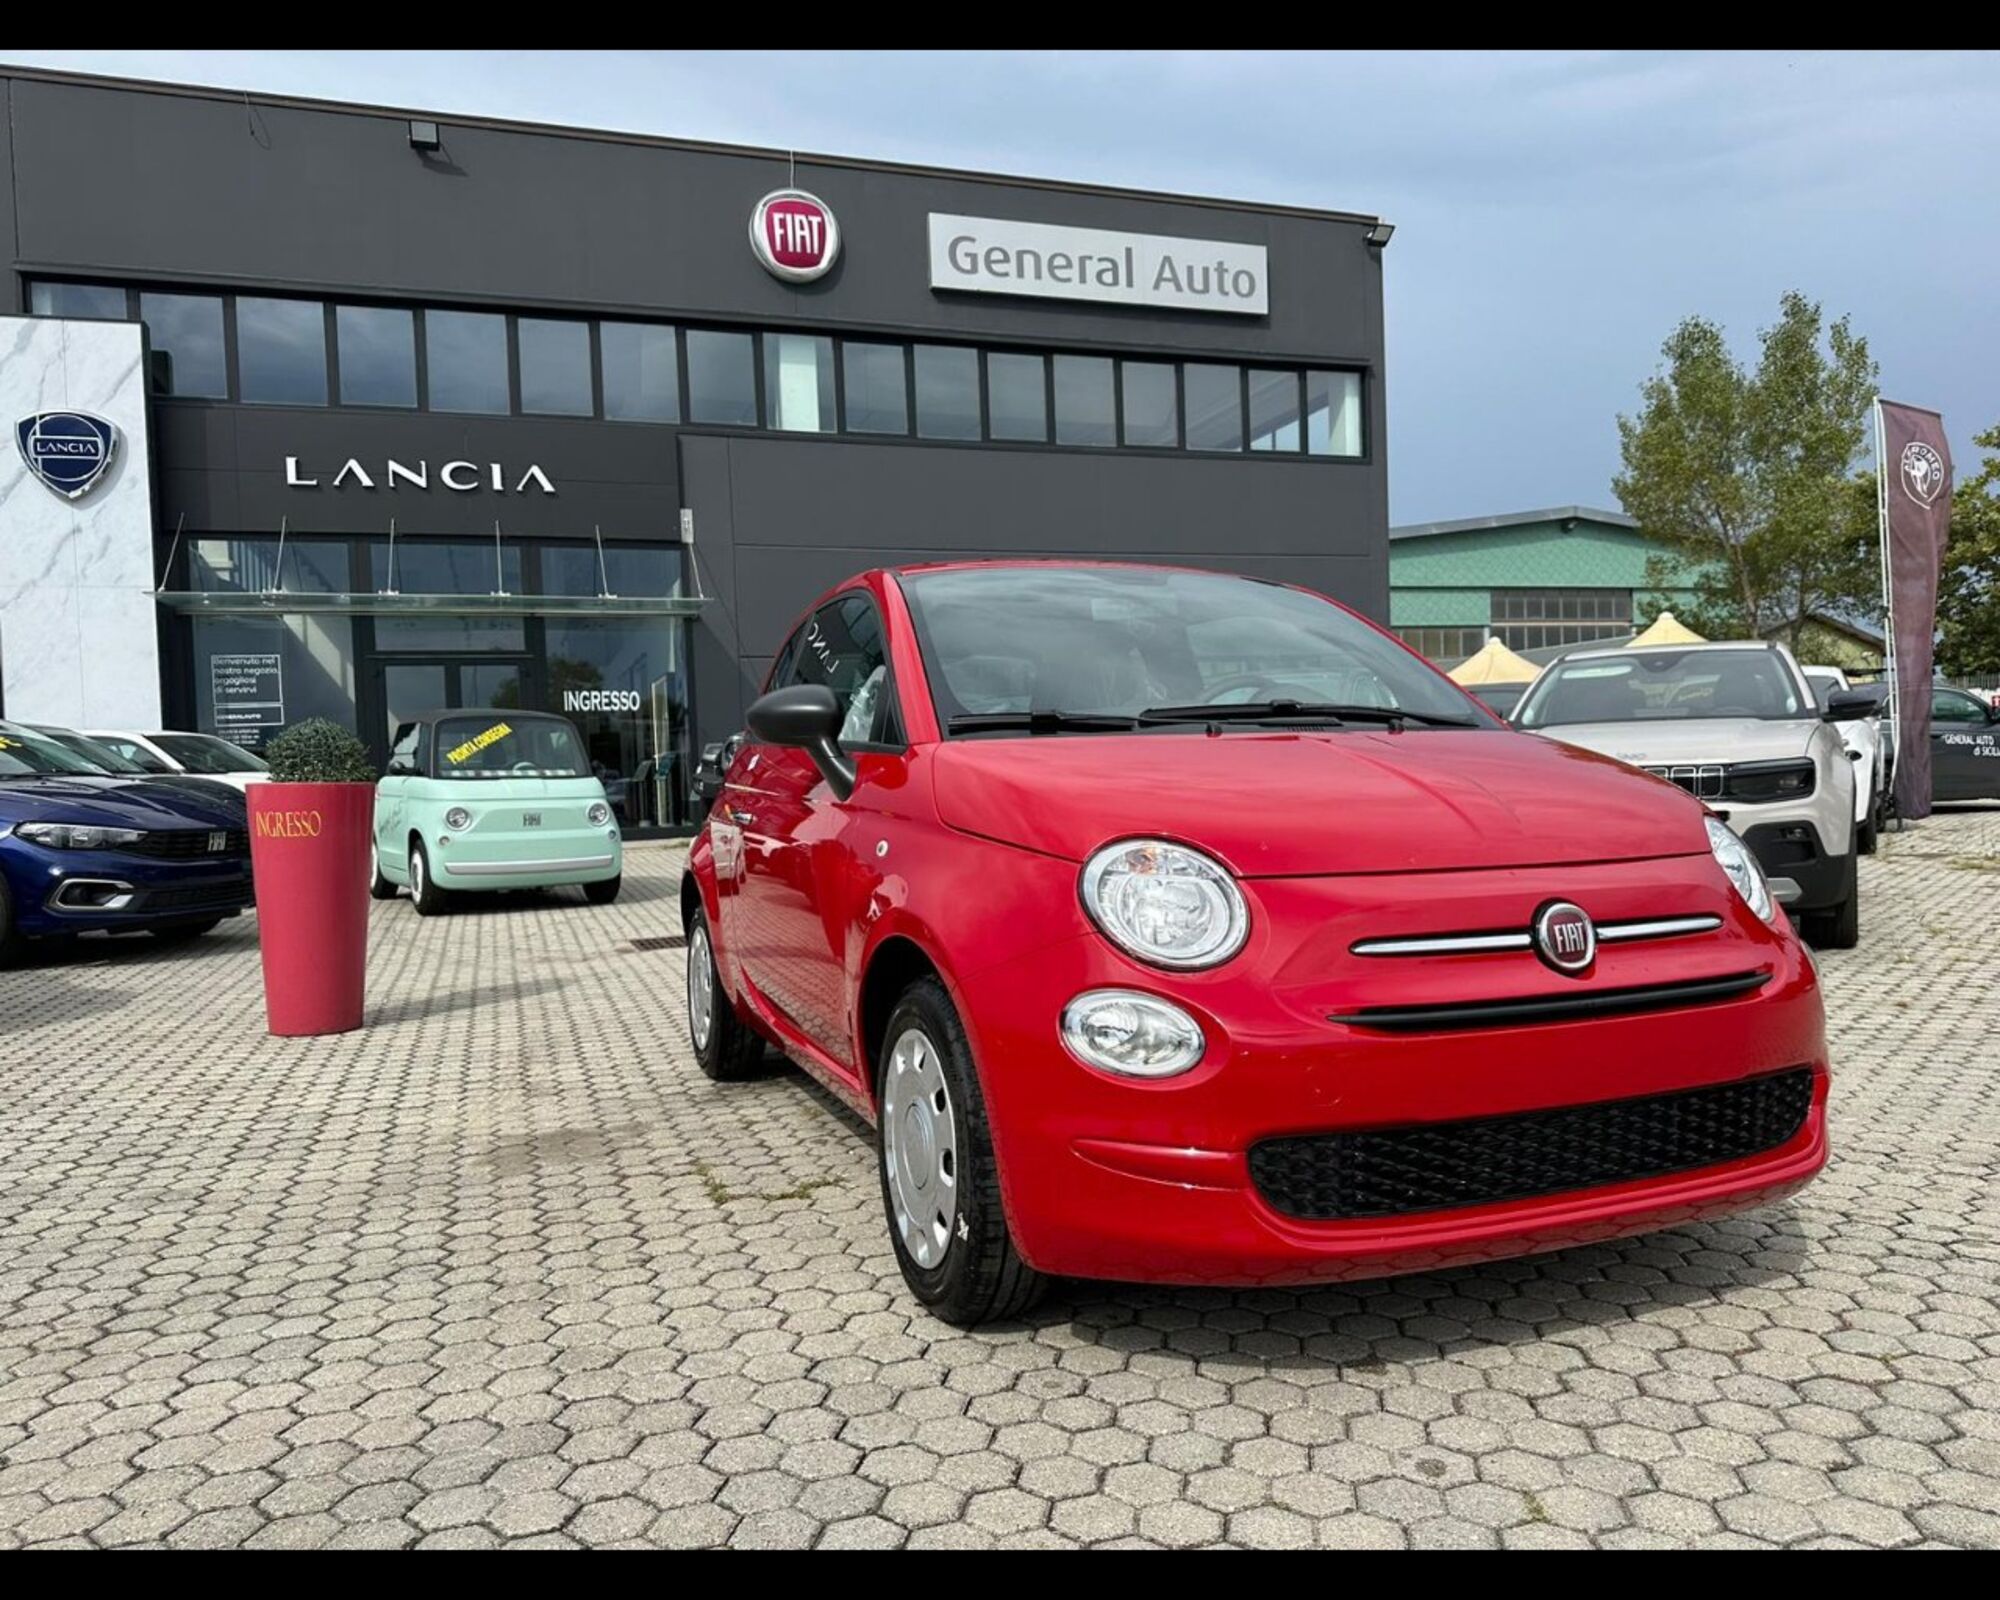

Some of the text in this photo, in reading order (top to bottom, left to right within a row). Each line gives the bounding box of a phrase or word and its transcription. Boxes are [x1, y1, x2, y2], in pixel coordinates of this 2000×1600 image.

[772, 212, 822, 255] FIAT
[947, 234, 1257, 299] General Auto
[36, 441, 96, 454] LANCIA
[285, 456, 556, 493] LANCIA
[563, 690, 641, 711] INGRESSO
[1553, 922, 1586, 954] FIAT
